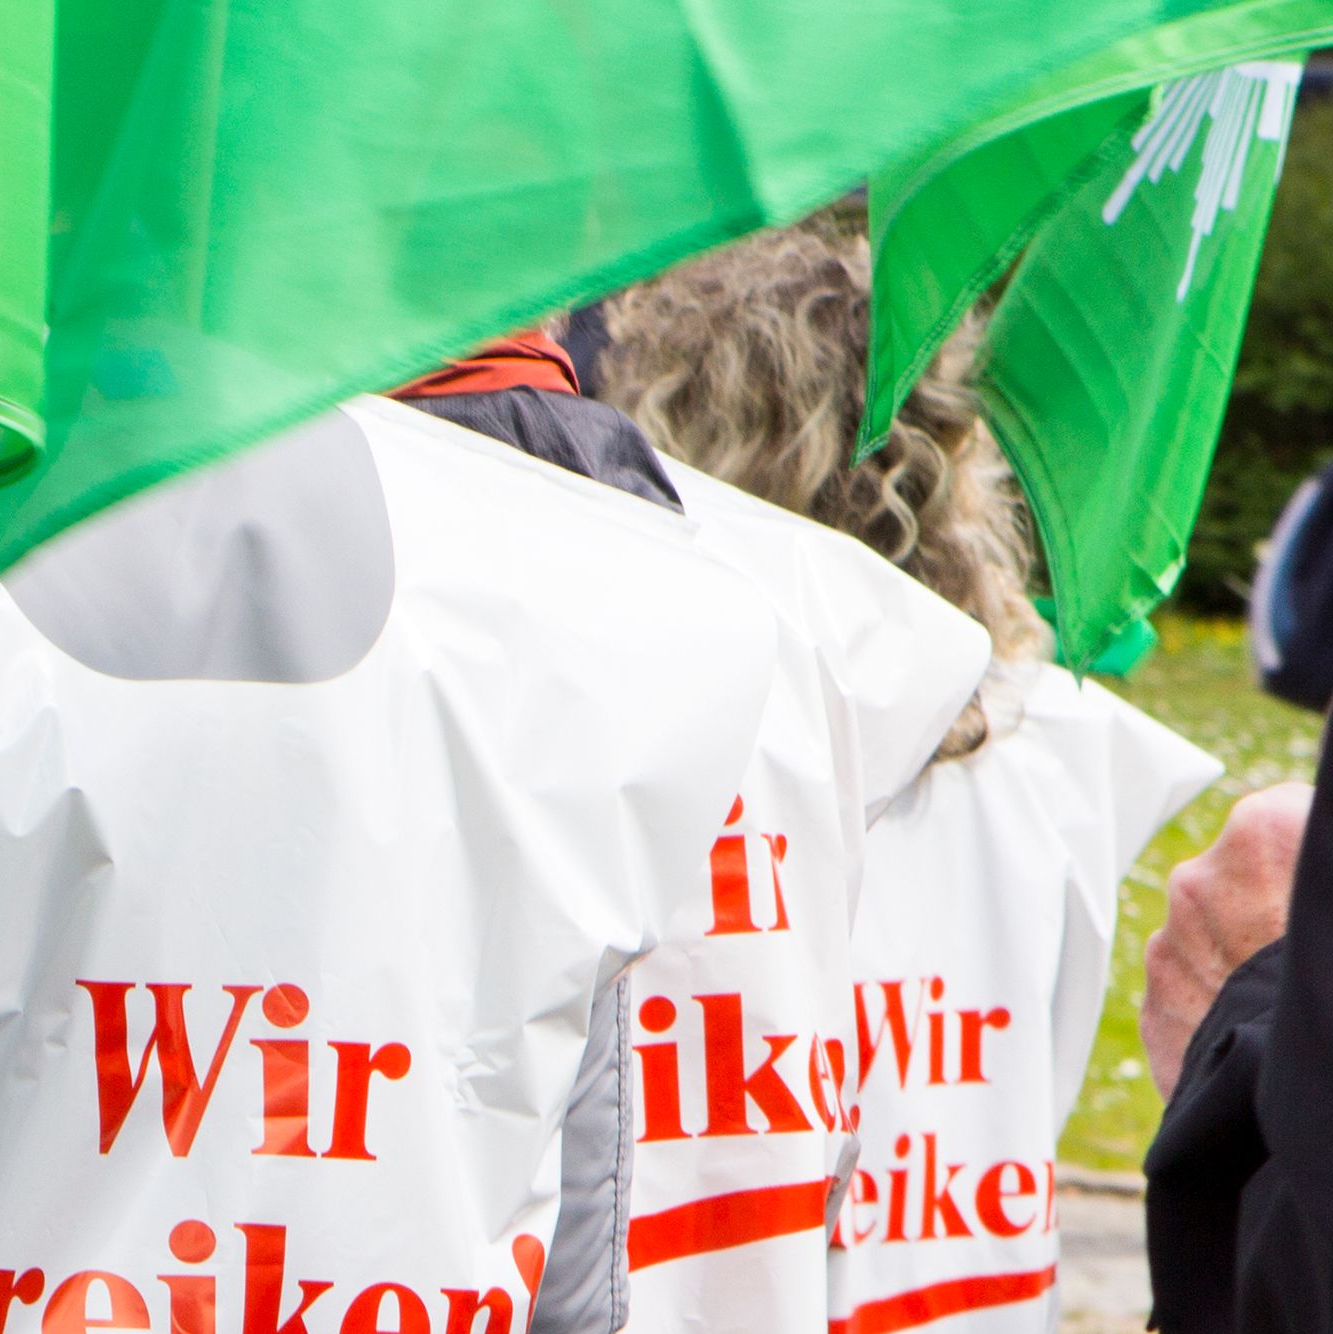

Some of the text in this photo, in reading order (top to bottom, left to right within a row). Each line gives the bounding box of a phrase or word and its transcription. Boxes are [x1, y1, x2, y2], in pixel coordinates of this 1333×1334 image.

[703, 793, 791, 937] ir
[75, 979, 413, 1162] Wir
[852, 975, 1012, 1093] Wir
